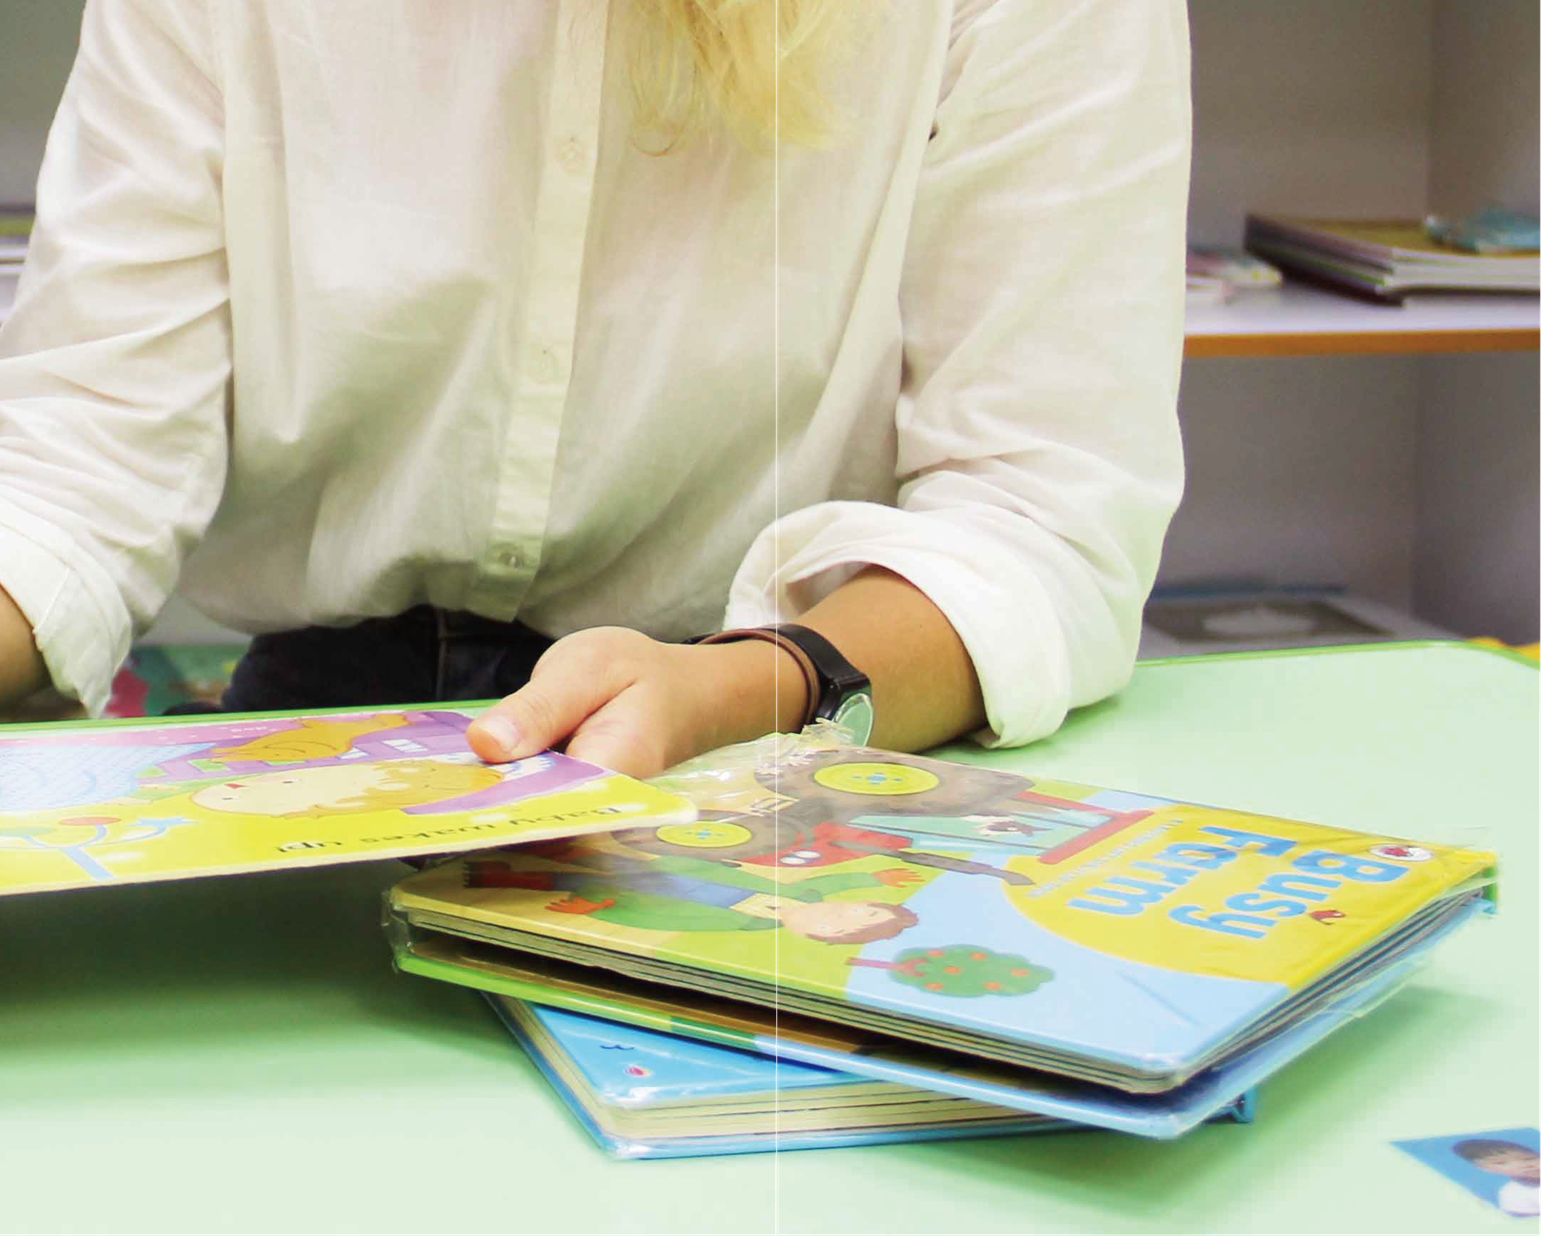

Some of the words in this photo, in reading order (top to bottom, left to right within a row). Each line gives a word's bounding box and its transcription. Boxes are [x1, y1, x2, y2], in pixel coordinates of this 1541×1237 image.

[357, 823, 495, 842] wakes
[508, 806, 621, 825] Baby
[1066, 824, 1298, 915] Farm
[1166, 848, 1410, 938] Busy
